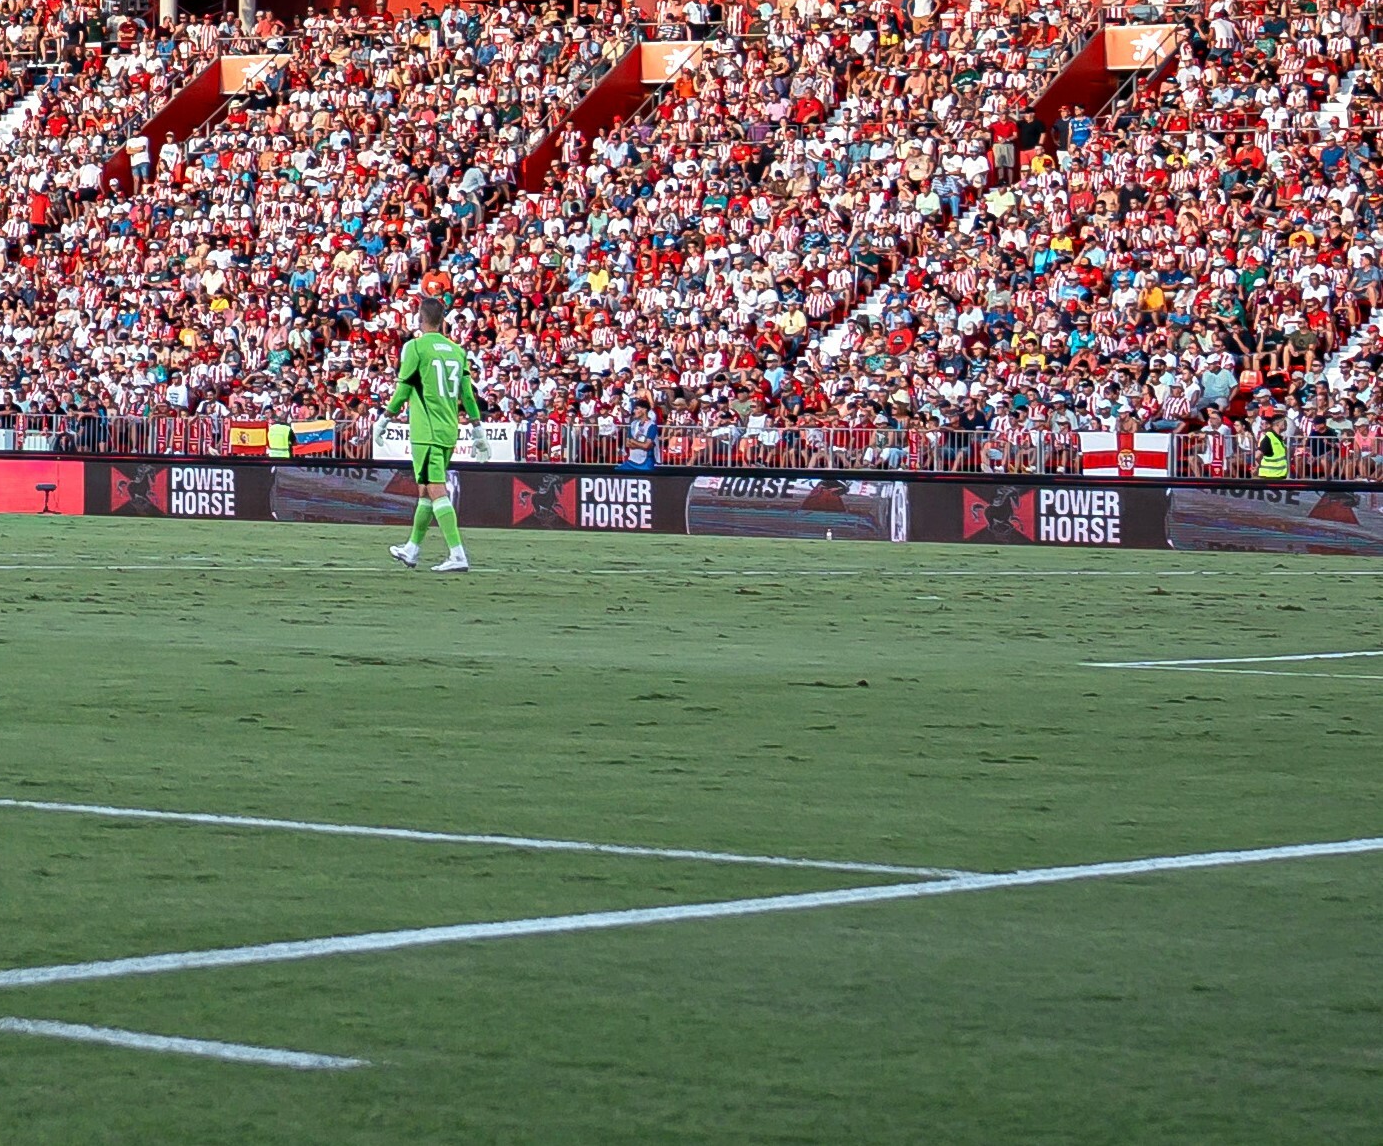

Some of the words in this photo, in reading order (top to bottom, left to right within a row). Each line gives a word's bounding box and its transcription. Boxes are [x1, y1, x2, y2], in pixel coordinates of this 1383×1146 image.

[431, 359, 460, 398] 13
[171, 467, 235, 492] POWER
[580, 477, 652, 503] POWER
[717, 477, 795, 499] HORSE
[171, 491, 235, 516] HORSE
[1040, 489, 1120, 516] POWER
[580, 503, 652, 529] HORSE
[1040, 516, 1121, 544] HORSE
